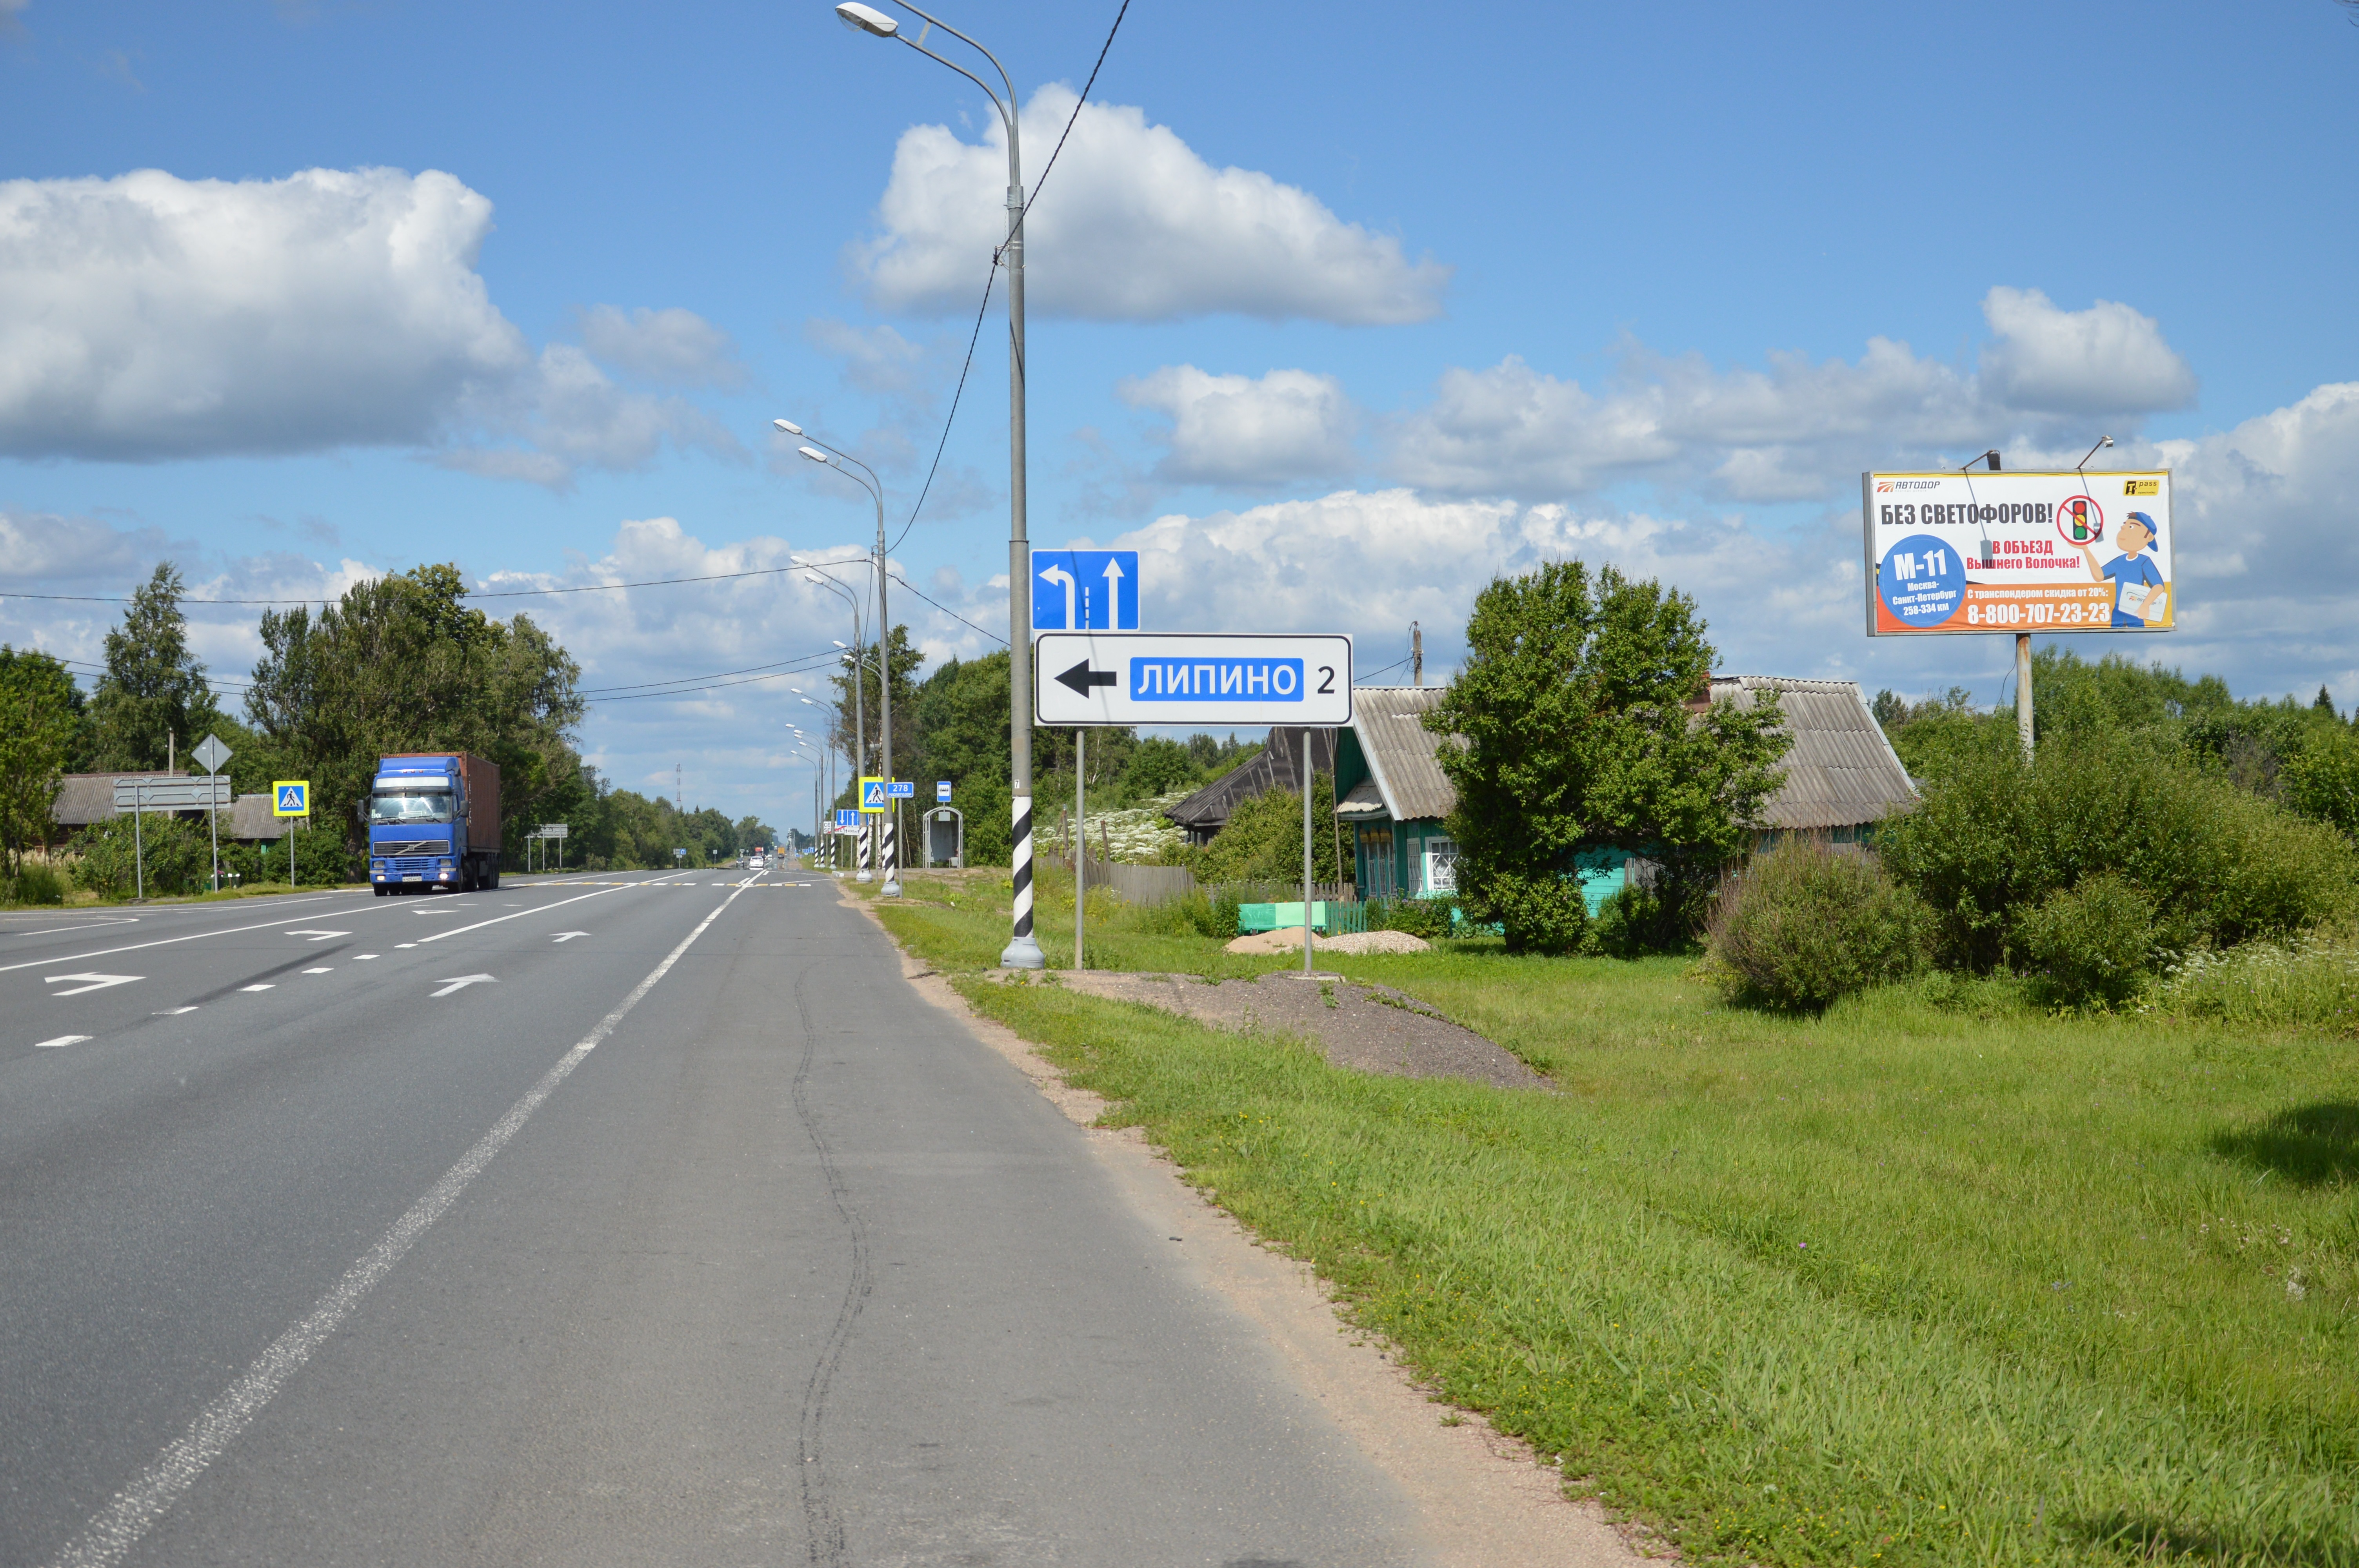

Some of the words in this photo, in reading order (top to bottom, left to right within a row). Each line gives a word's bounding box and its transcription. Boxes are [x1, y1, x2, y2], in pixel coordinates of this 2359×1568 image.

[1881, 505, 1916, 524] БЕЗ
[1921, 503, 2053, 524] СВЕТОФОРОВ!
[1992, 541, 2001, 554] В
[2004, 540, 2054, 555] ОБЪЕЗД
[1894, 549, 1947, 581] М-11
[1966, 557, 2023, 569] Вышнего
[2025, 556, 2080, 569] Волочка!
[1907, 581, 1939, 592] Москва-
[1967, 589, 1974, 599] С
[1974, 589, 2043, 599] транспондером
[2044, 589, 2076, 598] скидка
[2088, 588, 2108, 597] 20%:
[1892, 590, 1957, 605] Санкт-Петербург
[1903, 603, 1936, 616] 258-334
[1968, 603, 2110, 624] 8-800-707-23-23
[1138, 664, 1296, 695] ЛИПИНО
[1318, 666, 1335, 694] 2
